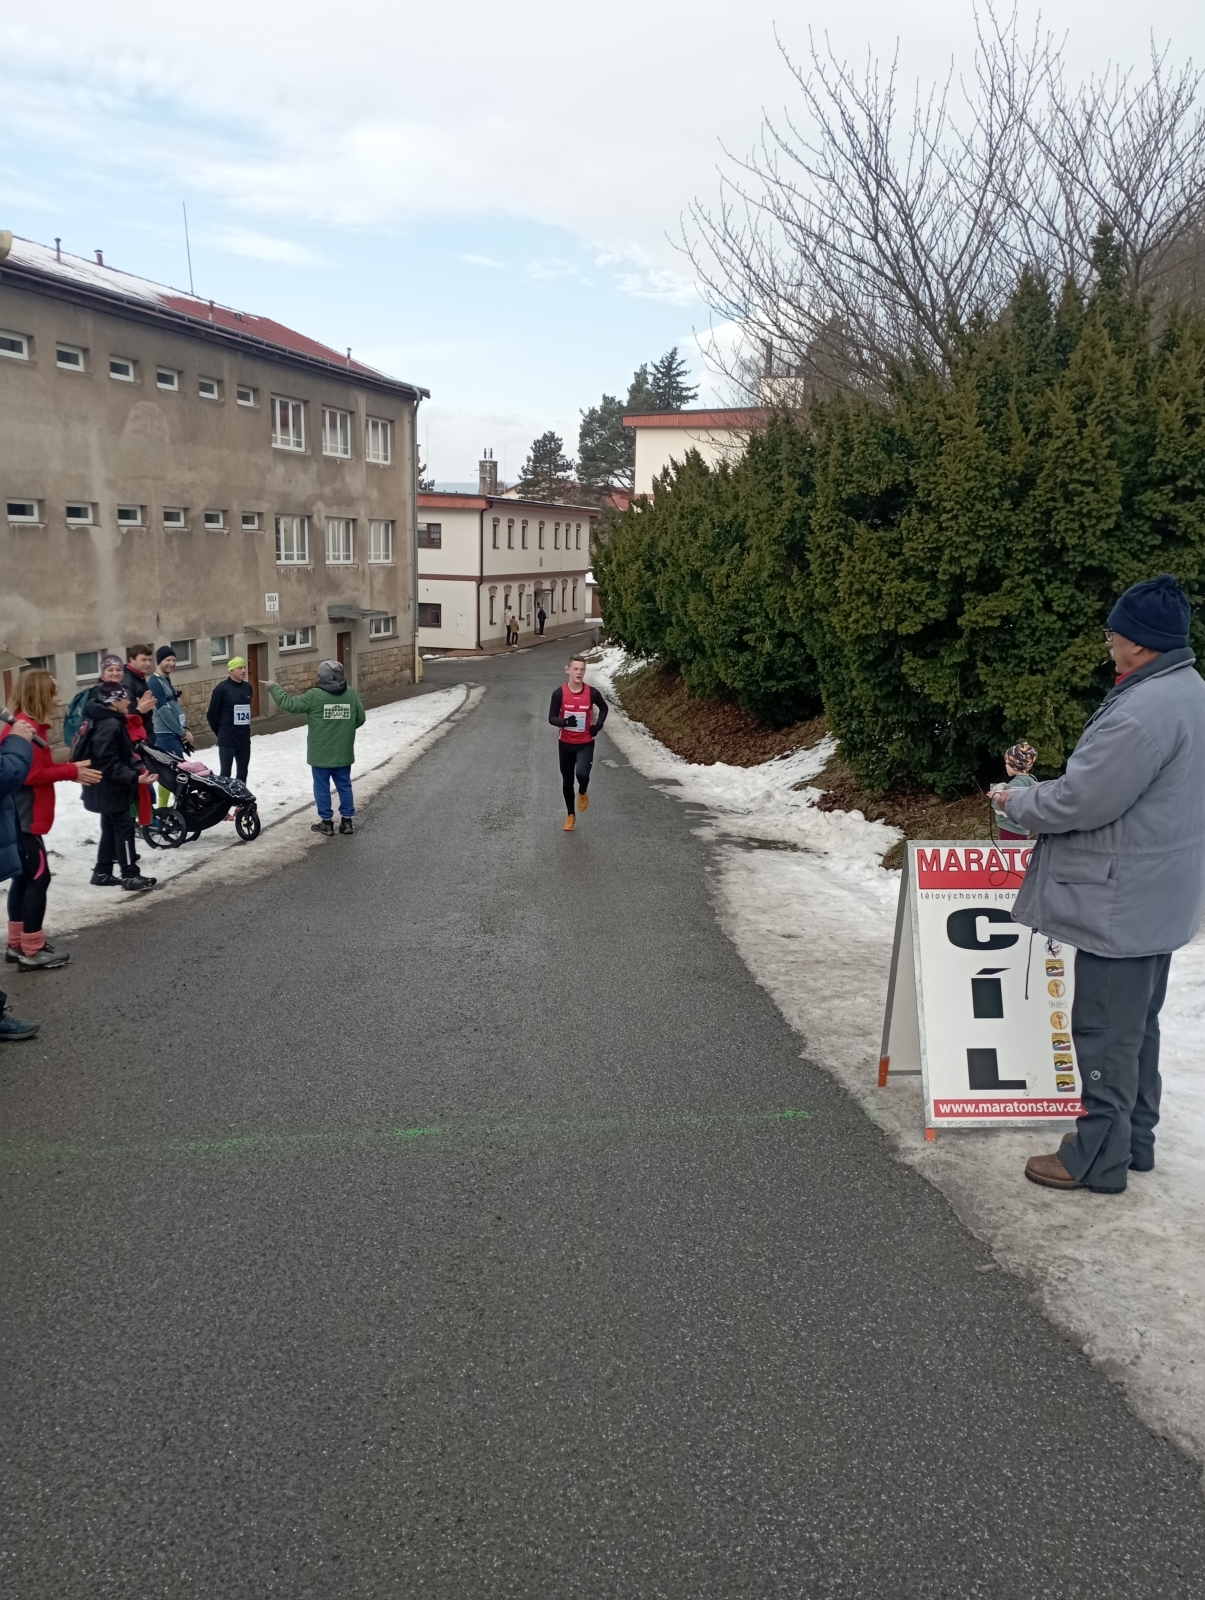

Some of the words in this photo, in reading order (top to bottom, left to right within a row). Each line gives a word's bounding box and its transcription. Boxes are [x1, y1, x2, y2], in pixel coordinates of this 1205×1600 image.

[237, 712, 249, 720] 124
[920, 891, 990, 901] tělovýchovná
[938, 1101, 1083, 1114] www.maratonstav.cz
